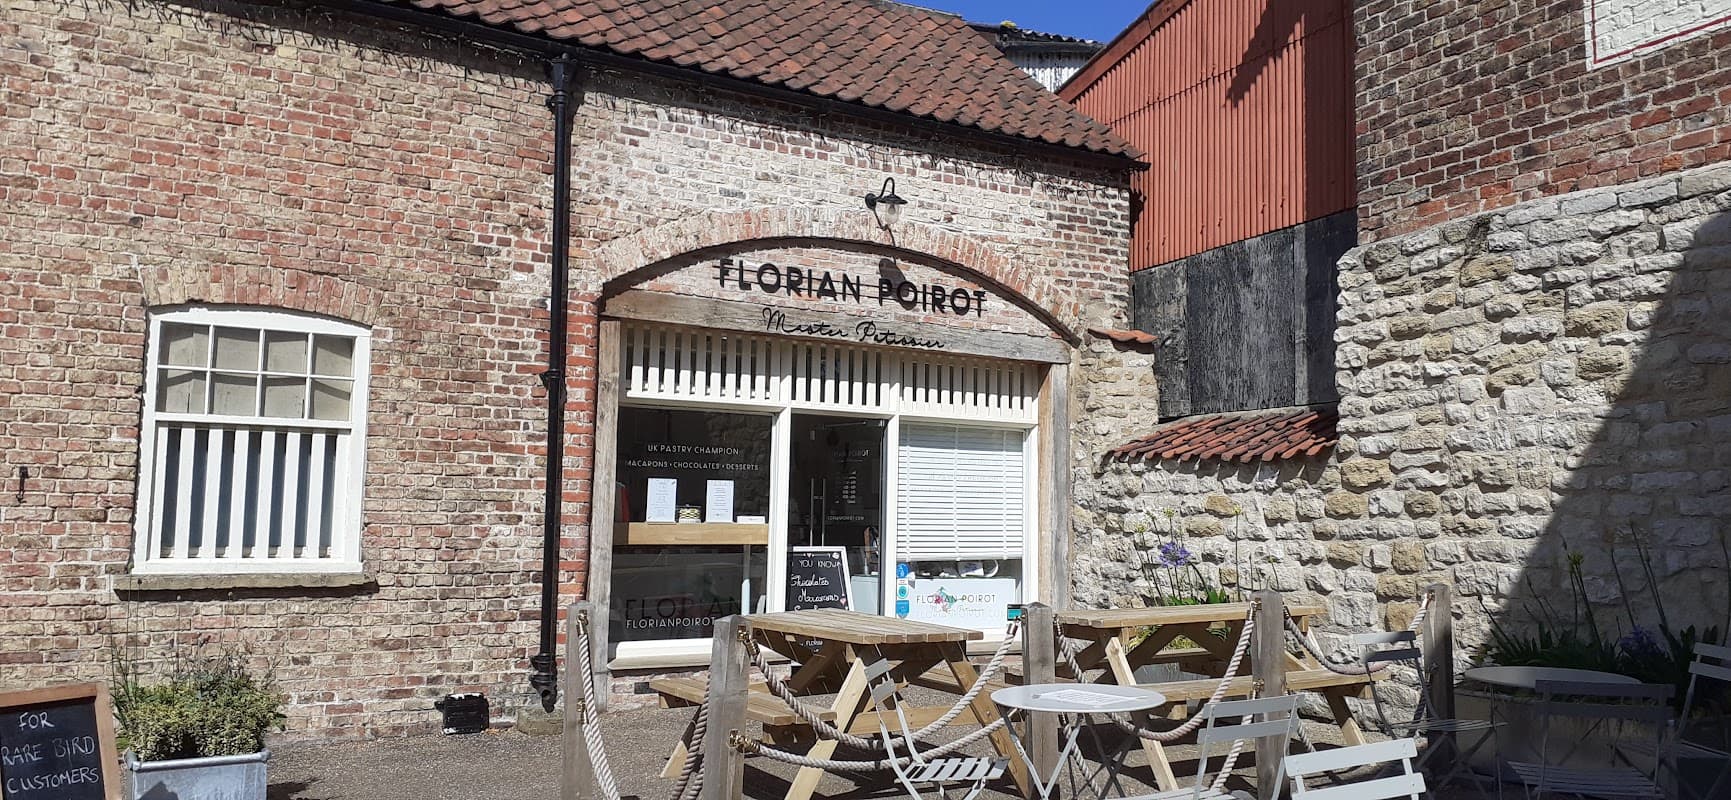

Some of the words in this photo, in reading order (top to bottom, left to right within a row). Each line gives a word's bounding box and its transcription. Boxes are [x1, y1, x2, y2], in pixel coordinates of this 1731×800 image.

[719, 258, 860, 304] FLORIAN
[878, 277, 988, 318] POIROT
[762, 307, 849, 338] Master
[647, 444, 658, 452] UK
[660, 444, 692, 453] PASTRY
[694, 446, 739, 455] CHAMPION
[626, 460, 668, 468] MACARONS
[673, 461, 720, 470] CHOCOLATES
[726, 463, 759, 471] DESSERTS
[799, 559, 814, 568] YOU
[961, 594, 996, 604] POIROT
[19, 712, 55, 730] FOR
[1, 744, 43, 765] RARE
[53, 736, 95, 761] BIRD
[7, 767, 99, 793] CUSTOMERS
